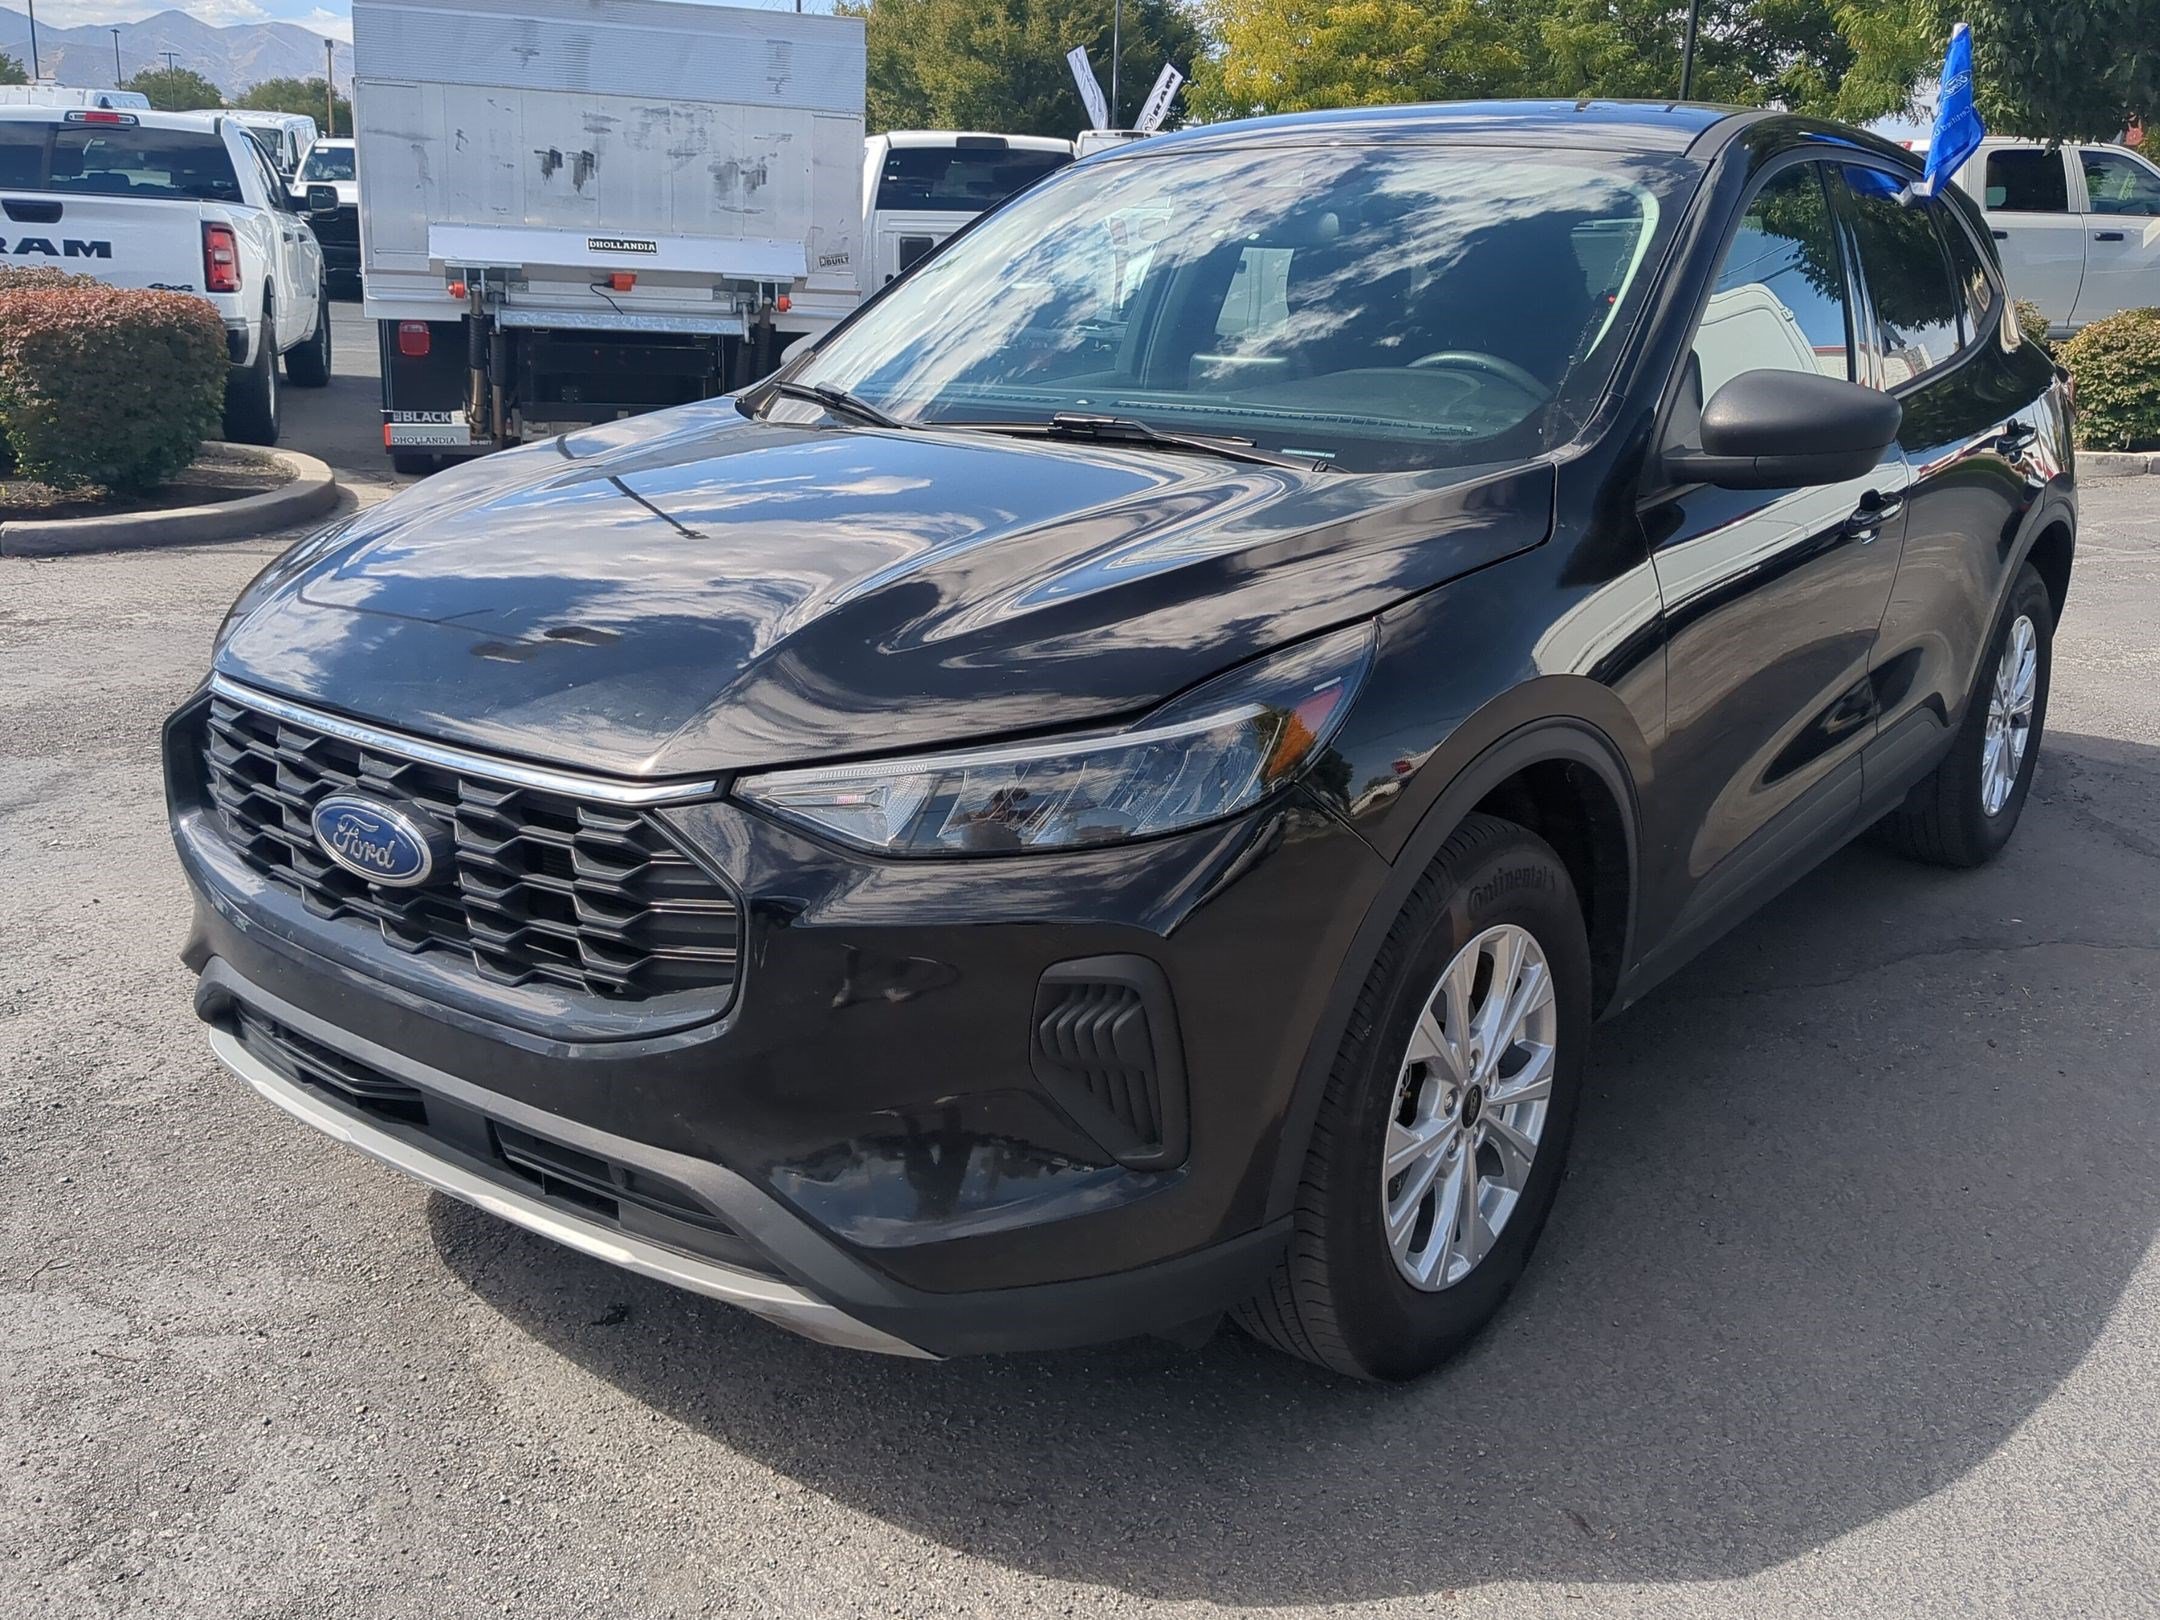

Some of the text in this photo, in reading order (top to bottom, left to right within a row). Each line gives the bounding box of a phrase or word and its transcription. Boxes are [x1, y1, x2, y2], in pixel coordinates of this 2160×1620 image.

[1153, 72, 1176, 116] RAM
[0, 236, 112, 259] AM
[589, 240, 656, 251] DHOLLANDIA
[402, 411, 452, 422] BLACK
[392, 436, 457, 445] DHOLLANDIA
[333, 813, 396, 869] Ford
